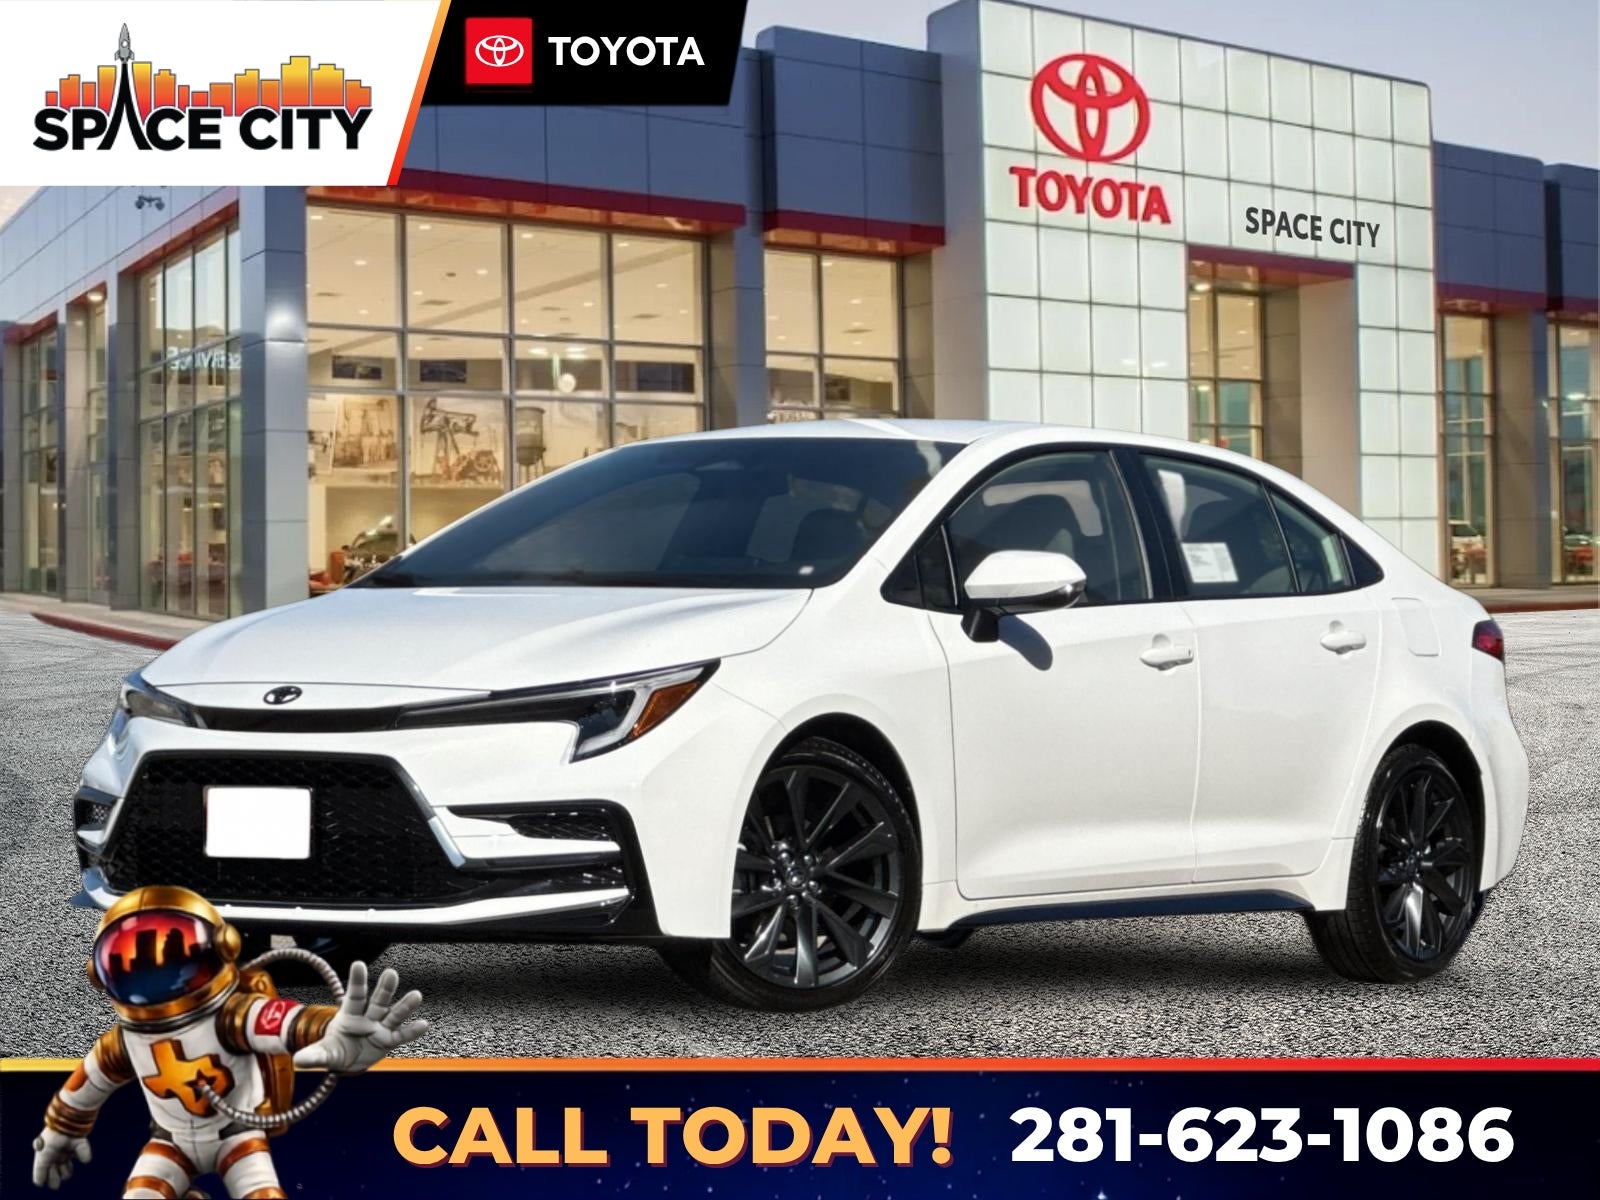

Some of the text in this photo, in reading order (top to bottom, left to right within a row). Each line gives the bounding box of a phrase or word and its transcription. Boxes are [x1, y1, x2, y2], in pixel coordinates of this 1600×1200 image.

[1010, 166, 1171, 224] TOYOTA
[1245, 206, 1381, 249] SPACE CITY
